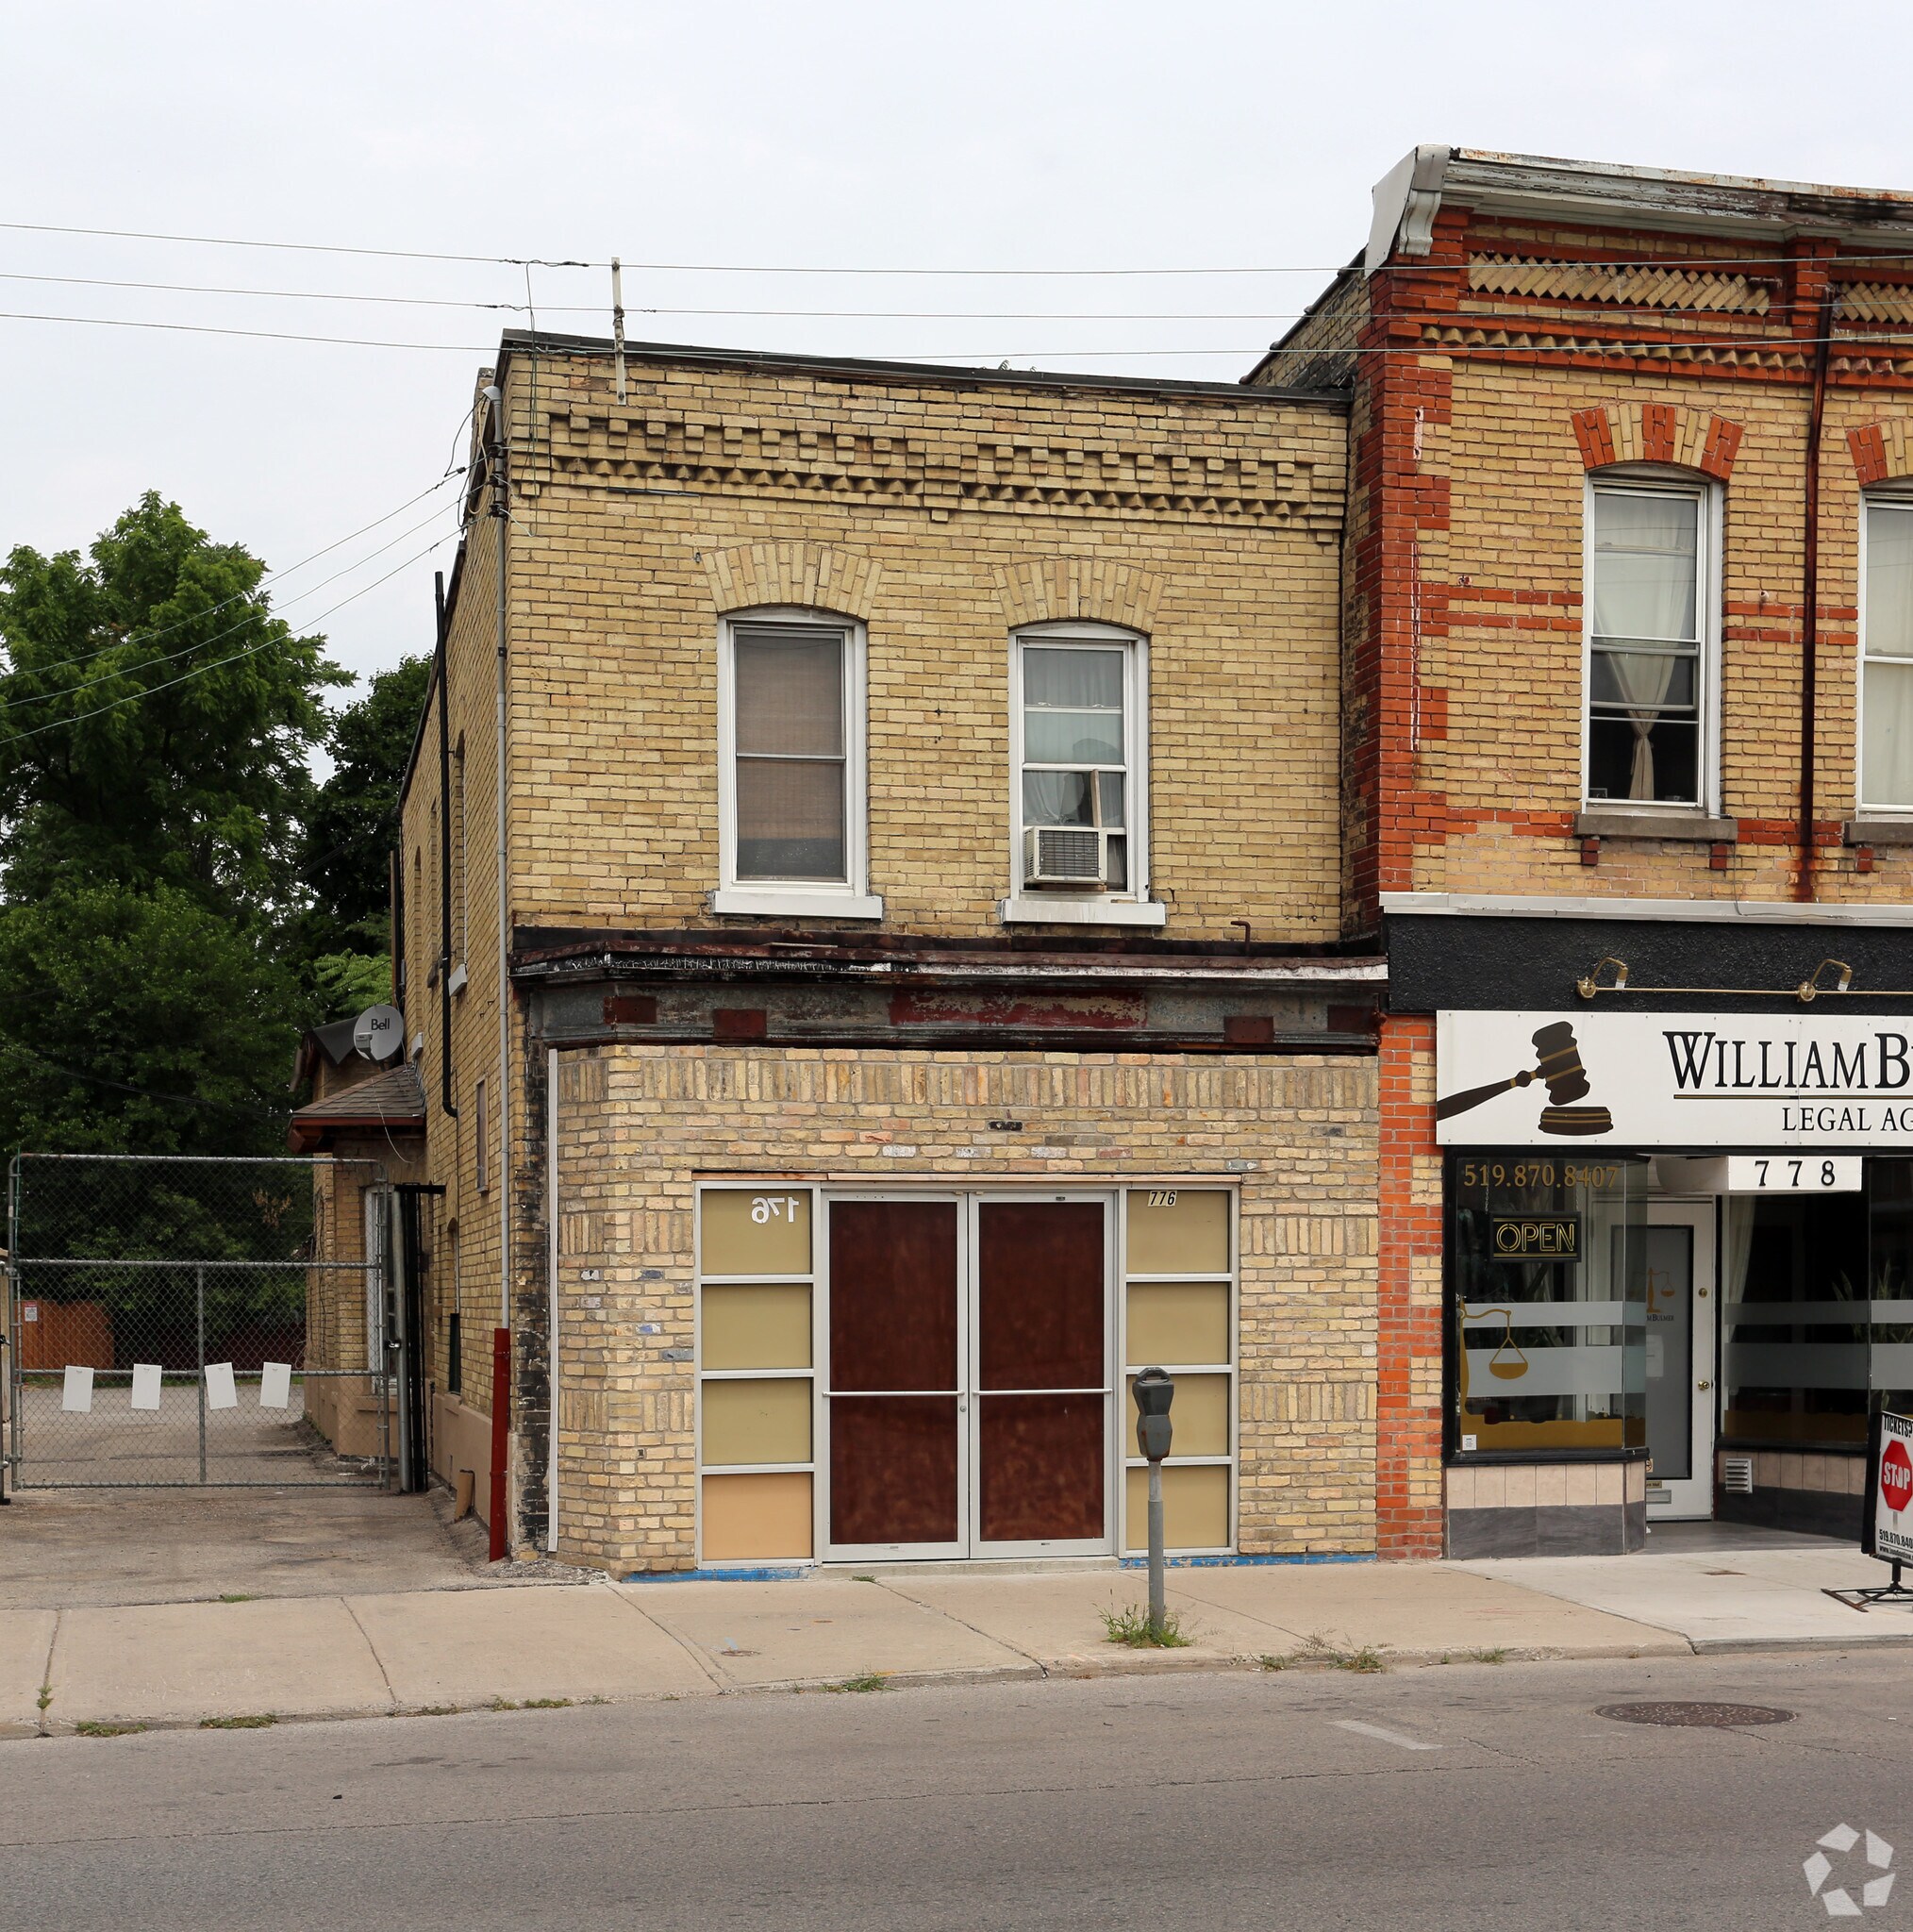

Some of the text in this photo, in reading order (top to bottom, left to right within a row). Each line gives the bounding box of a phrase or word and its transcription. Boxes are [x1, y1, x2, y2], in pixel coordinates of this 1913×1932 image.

[371, 1018, 390, 1030] Bell
[1782, 1107, 1871, 1131] LEGAL
[1463, 1164, 1620, 1189] 519.870.8407
[1150, 1191, 1176, 1206] 776
[1496, 1223, 1574, 1252] OPEN
[1884, 1461, 1911, 1491] STOP
[1879, 1528, 1913, 1549] 519.870.840
